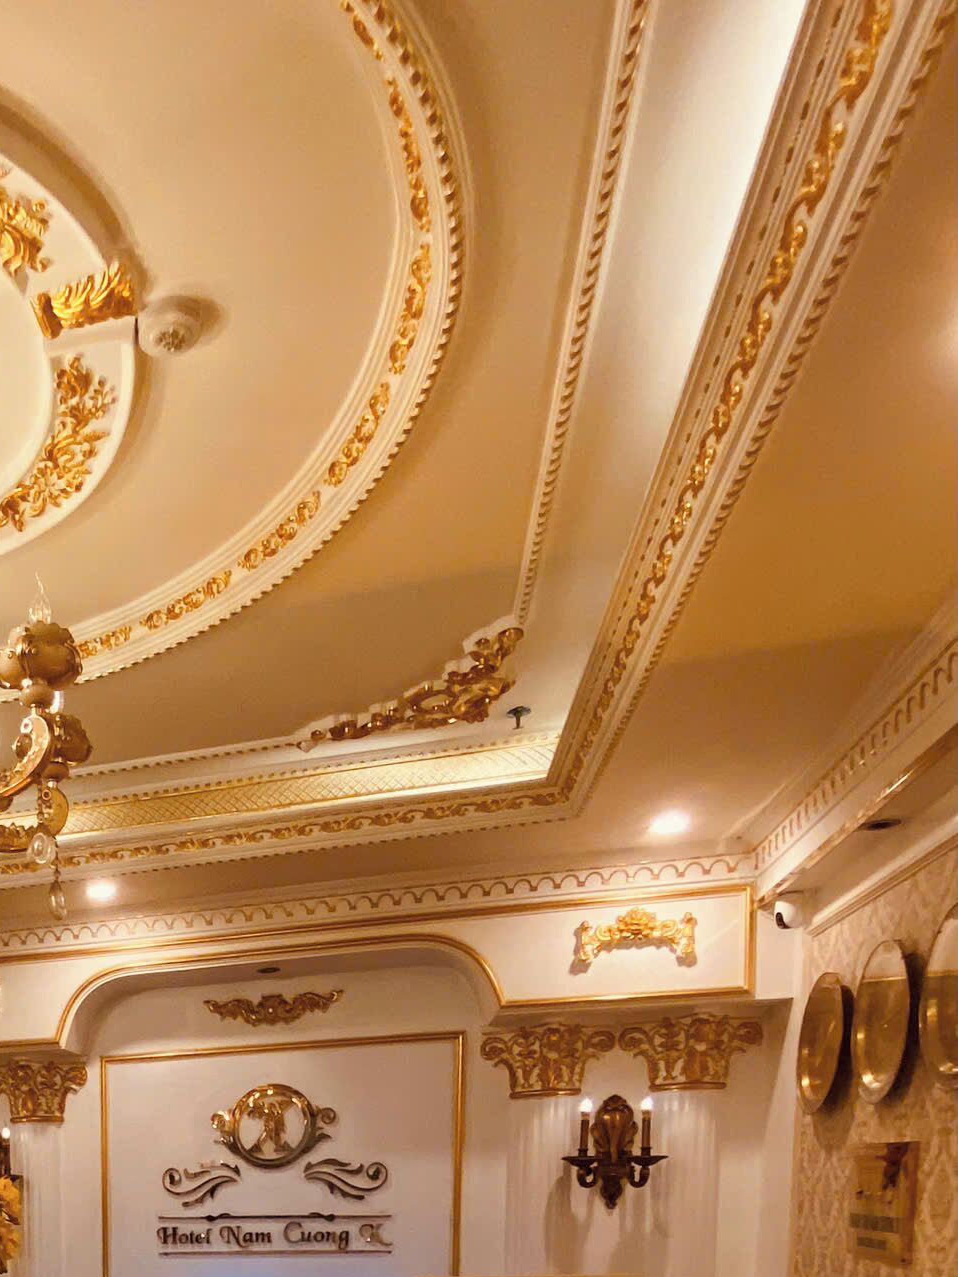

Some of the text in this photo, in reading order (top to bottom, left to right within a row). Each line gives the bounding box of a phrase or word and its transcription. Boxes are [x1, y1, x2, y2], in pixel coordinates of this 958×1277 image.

[156, 1226, 212, 1245] Hotel
[219, 1225, 272, 1248] Nam
[283, 1221, 350, 1249] Cuong
